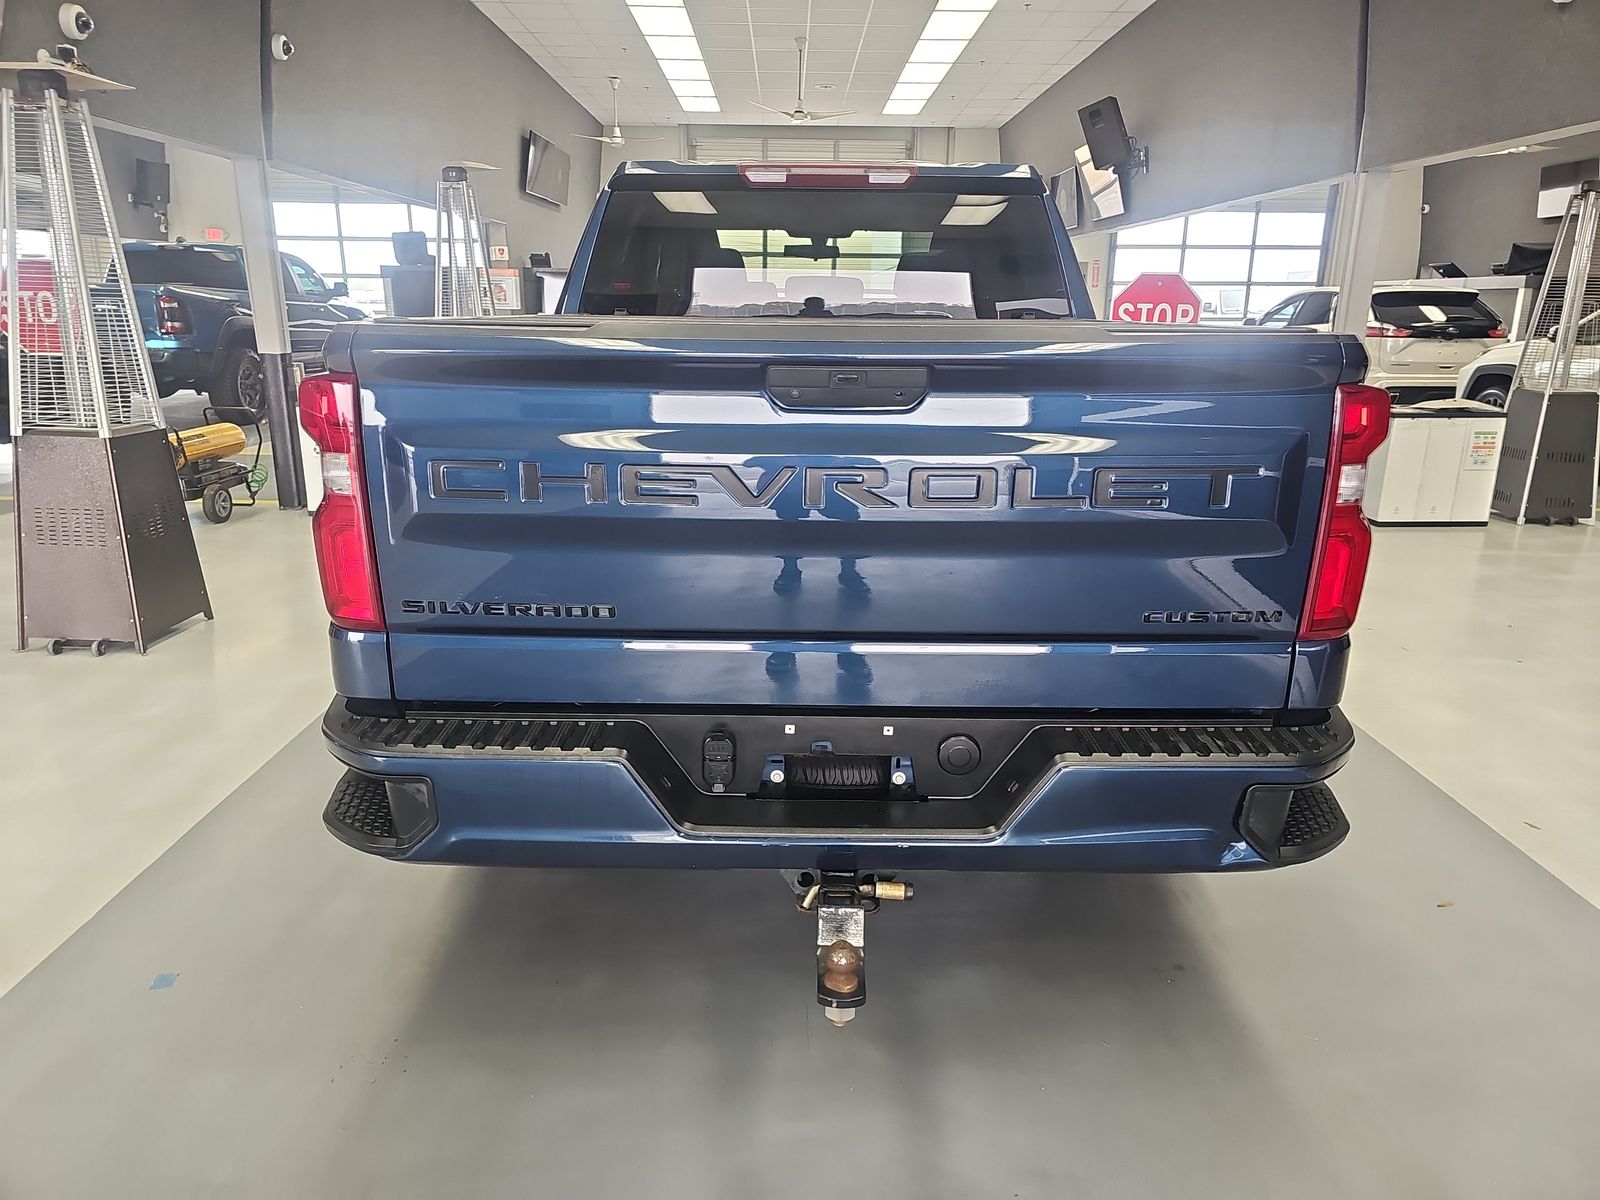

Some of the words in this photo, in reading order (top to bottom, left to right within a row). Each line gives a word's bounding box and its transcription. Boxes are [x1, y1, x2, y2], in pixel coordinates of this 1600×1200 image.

[1117, 302, 1196, 324] STOP
[427, 458, 1265, 511] CHEVROLET
[400, 599, 617, 619] SILVERADO
[1142, 610, 1283, 624] CUSTOM
